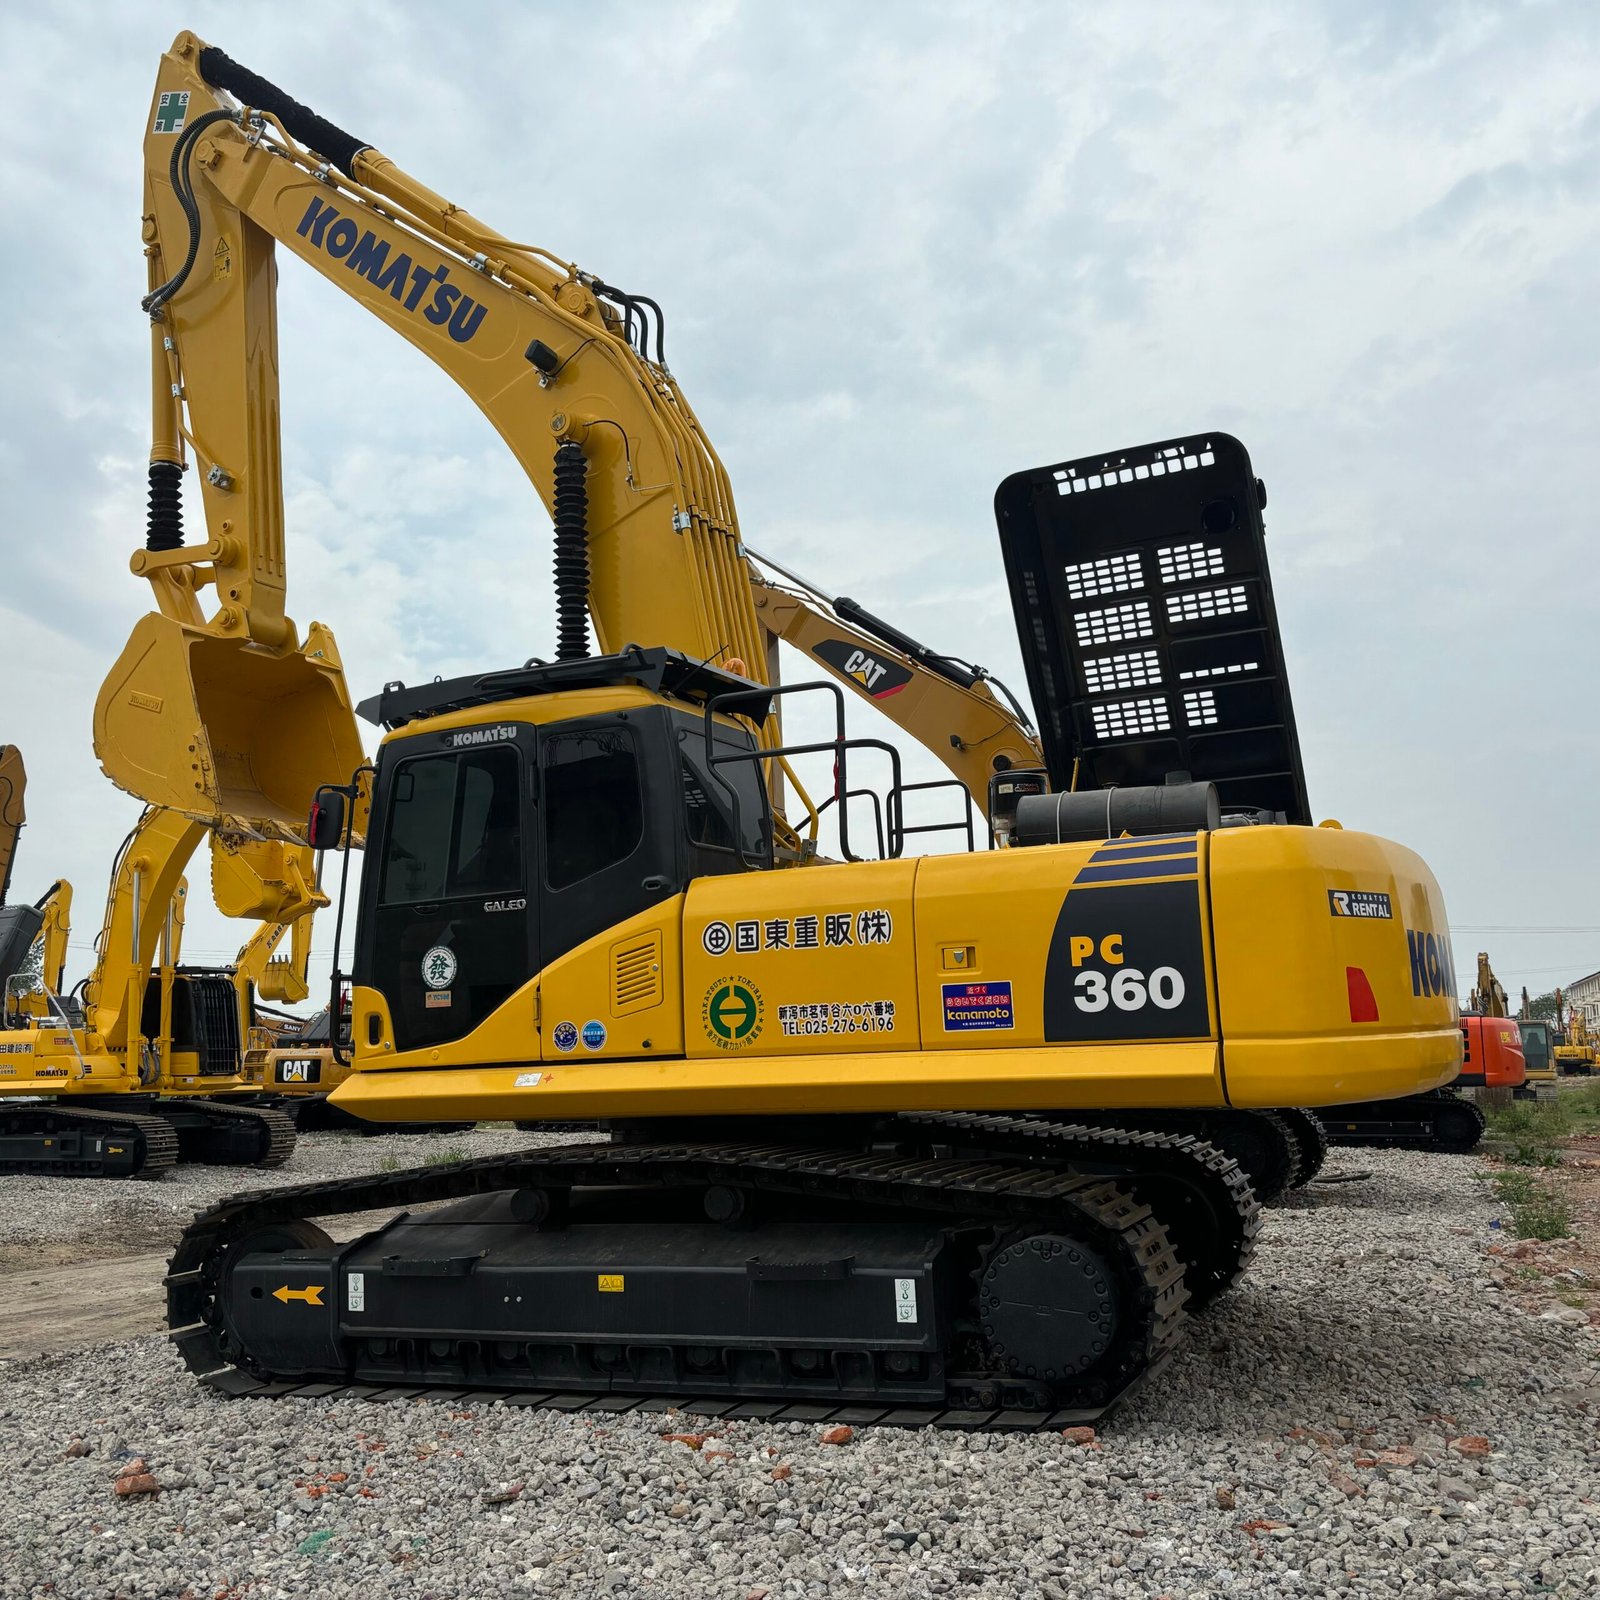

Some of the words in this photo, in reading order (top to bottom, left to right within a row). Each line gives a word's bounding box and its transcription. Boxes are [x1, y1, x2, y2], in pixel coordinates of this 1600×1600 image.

[296, 196, 489, 343] KOMATSU
[843, 649, 887, 689] CAT
[453, 725, 517, 747] KOMATSU
[483, 898, 527, 913] GALEO
[1352, 893, 1388, 902] KOMATSU
[1352, 902, 1390, 918] RENTAL
[1070, 934, 1125, 967] PC
[1073, 966, 1186, 1013] 360
[947, 1007, 1009, 1020] kanamoto
[782, 1017, 894, 1035] TEL:025-276-6196
[35, 1068, 69, 1077] KOMATSU
[283, 1060, 311, 1082] CAT
